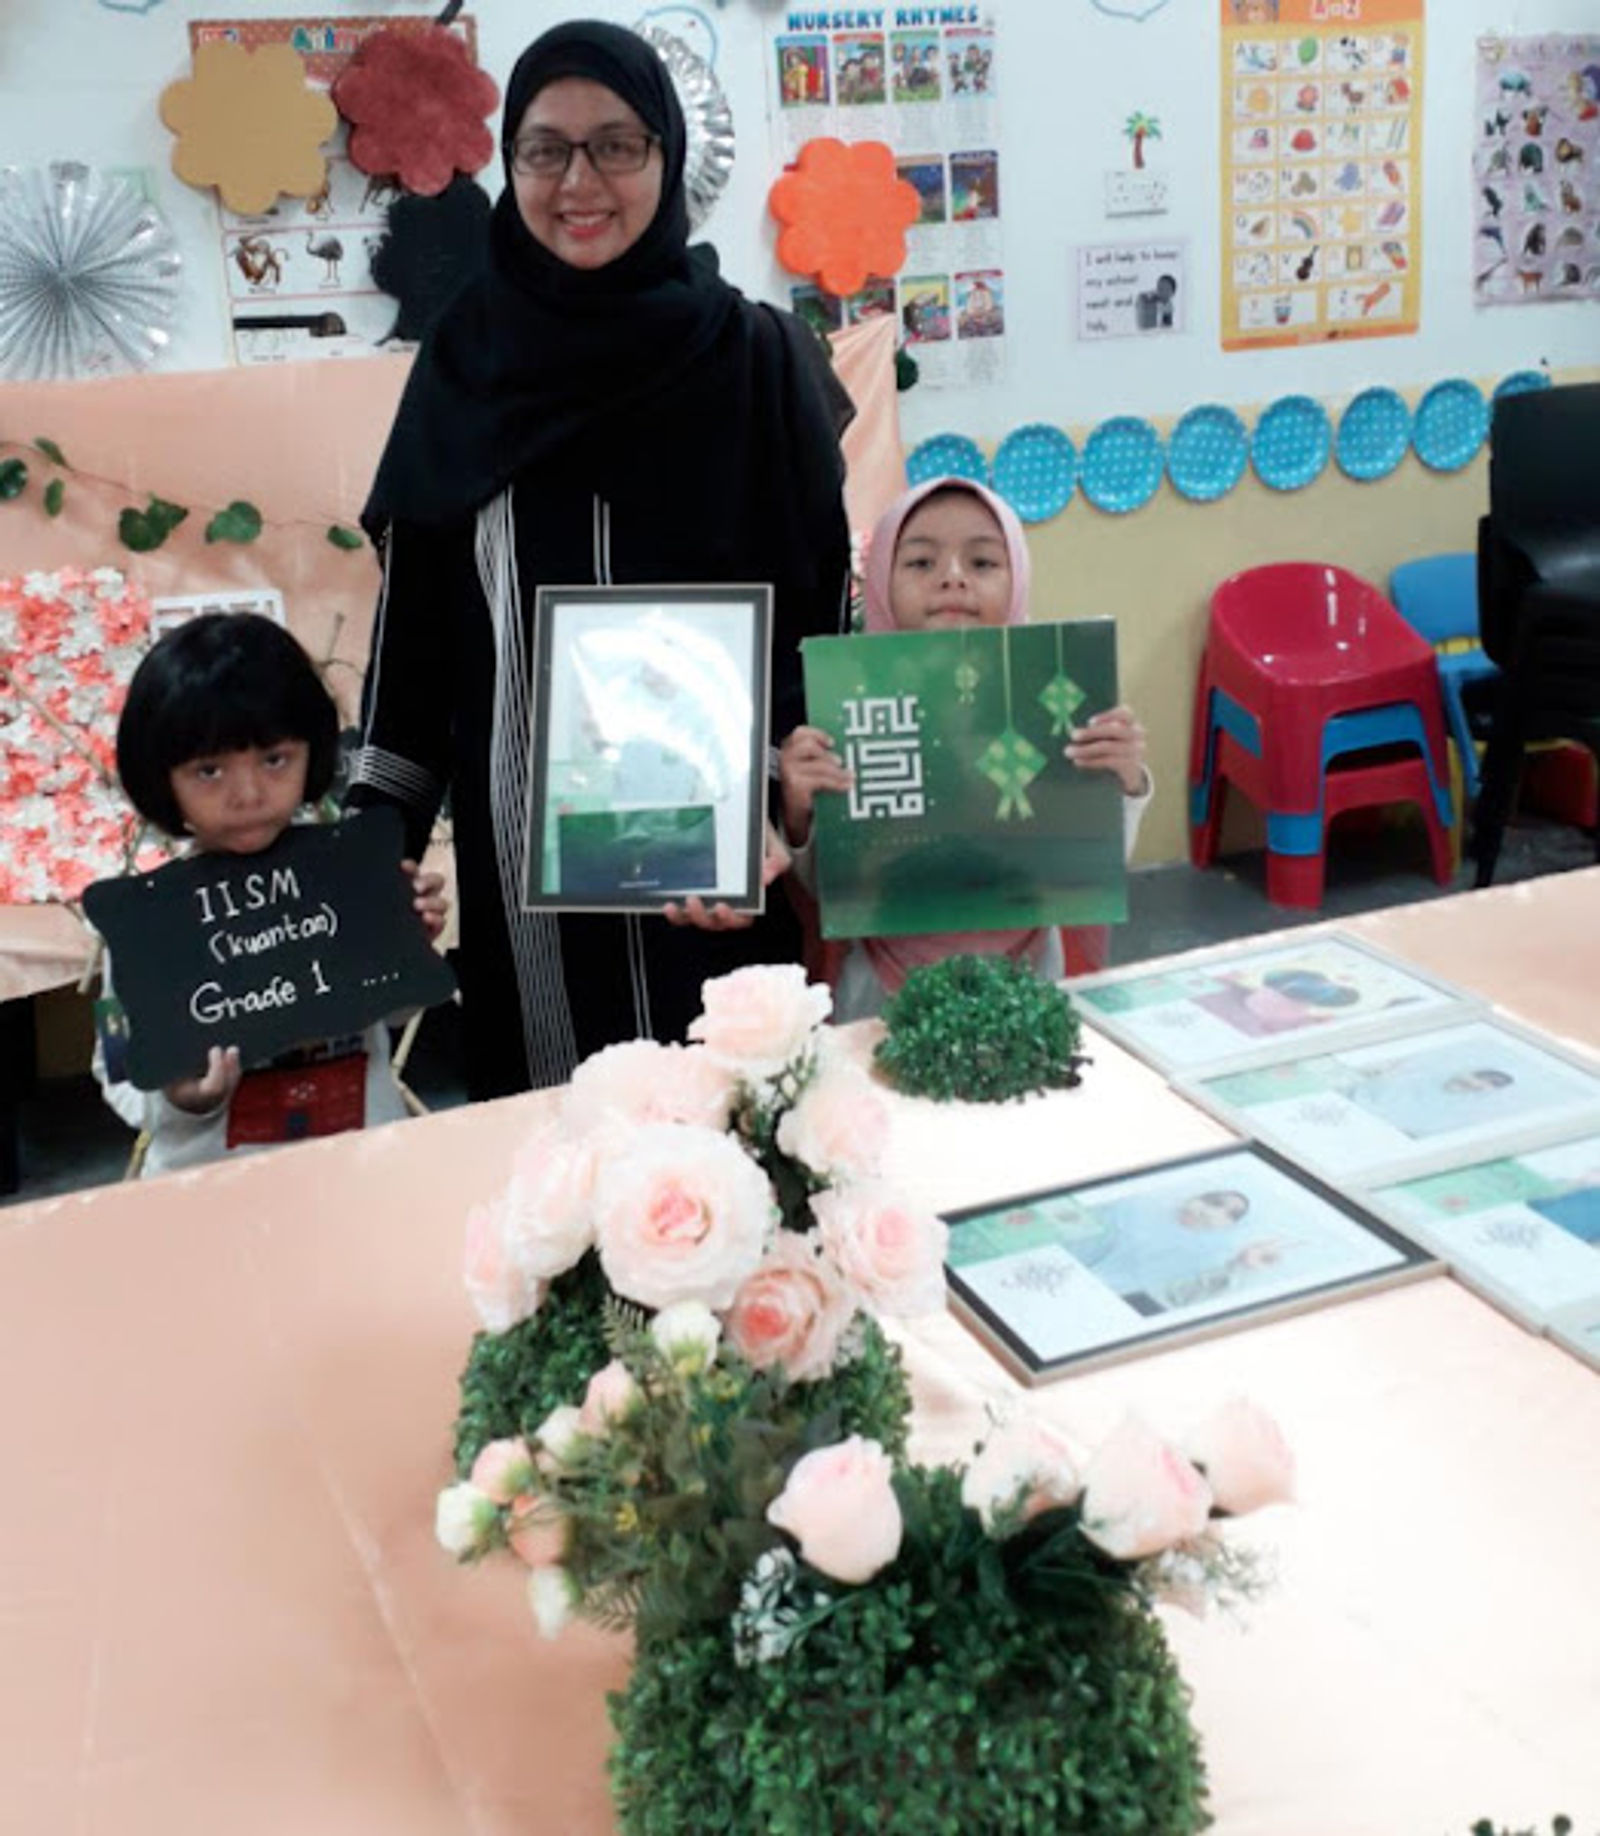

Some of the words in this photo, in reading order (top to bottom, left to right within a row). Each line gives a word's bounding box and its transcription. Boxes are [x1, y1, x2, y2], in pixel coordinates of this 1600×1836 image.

[788, 9, 883, 30] NURSERY
[896, 6, 978, 26] RHYMES
[1085, 278, 1103, 289] my
[1106, 274, 1138, 286] school
[1114, 296, 1134, 308] and
[195, 867, 301, 924] IISM
[189, 975, 297, 1024] Grade
[310, 960, 332, 996] 1
